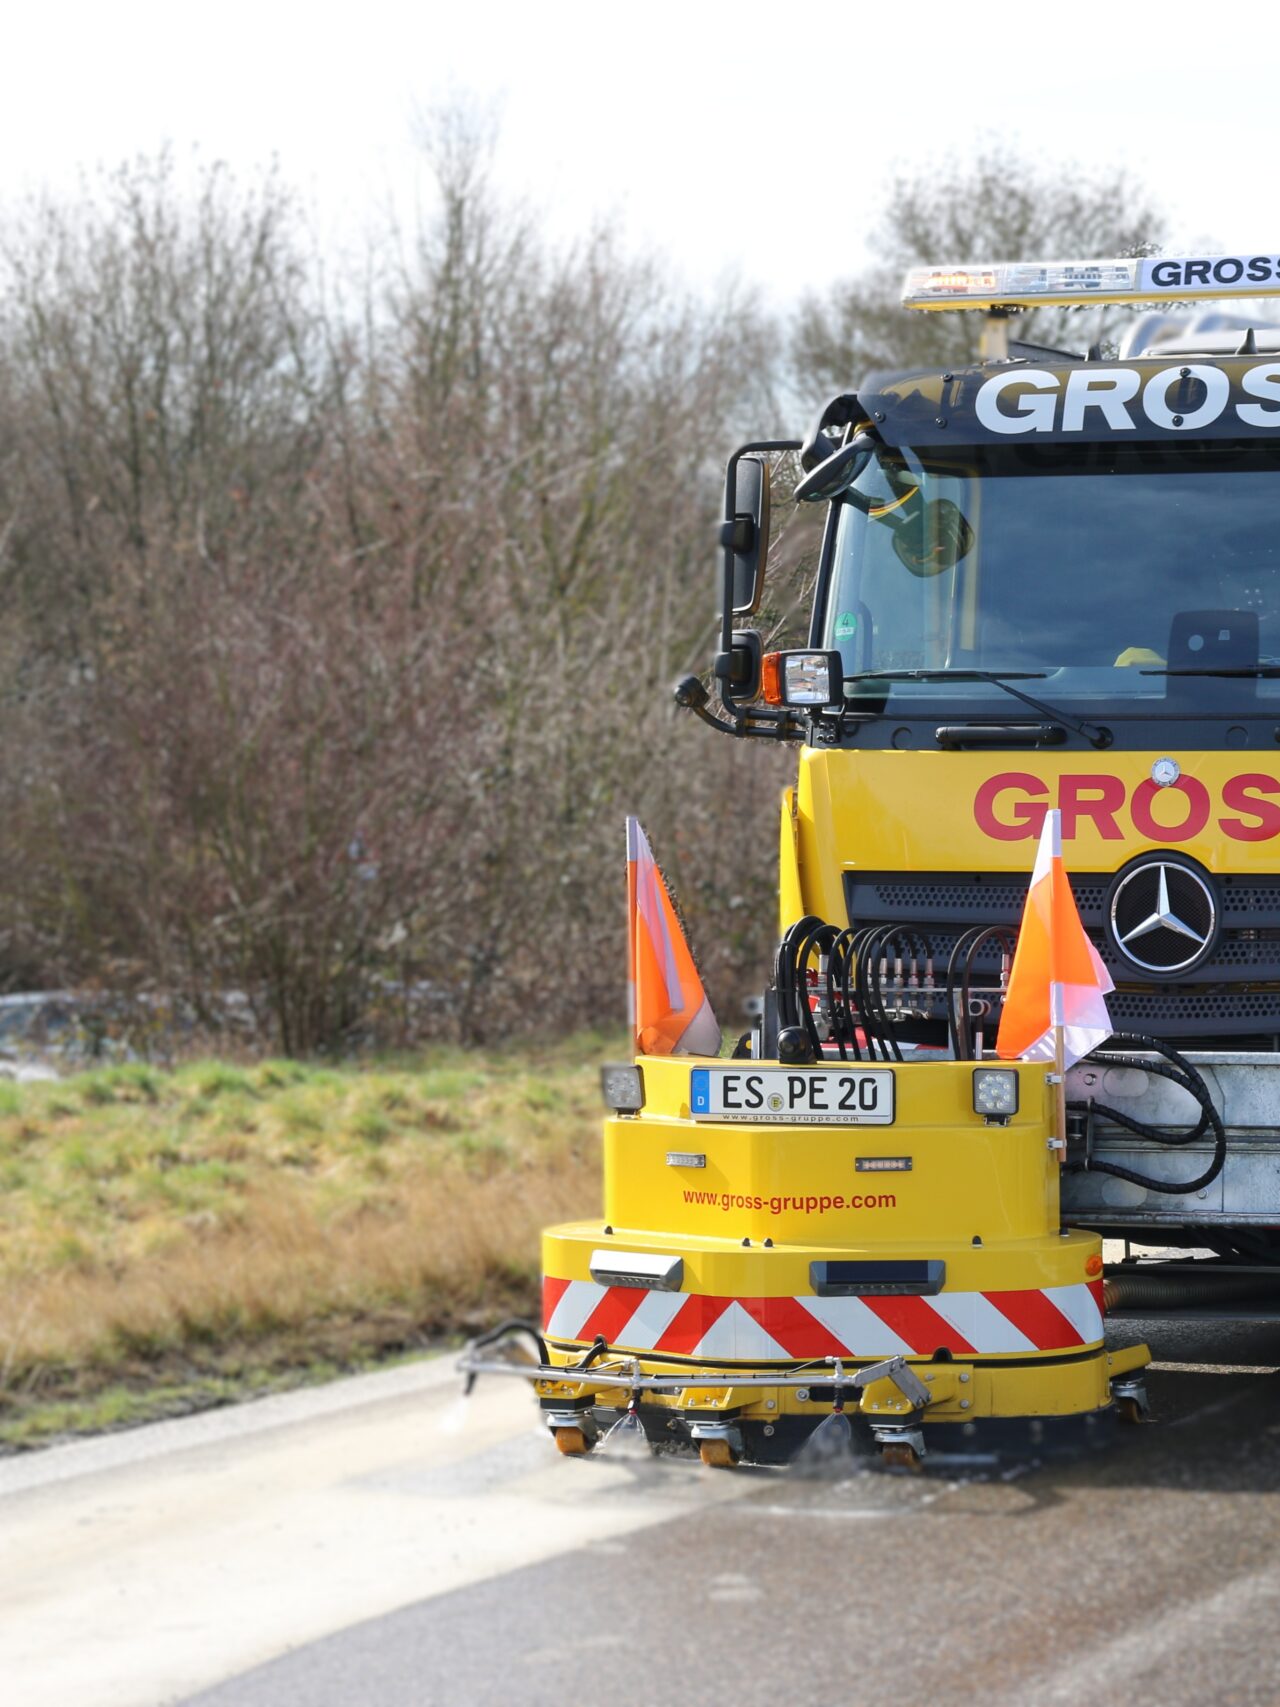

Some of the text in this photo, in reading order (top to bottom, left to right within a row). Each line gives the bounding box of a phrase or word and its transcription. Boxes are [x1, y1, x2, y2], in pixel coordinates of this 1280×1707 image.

[697, 1096, 704, 1105] D
[722, 1075, 878, 1111] ES PE 20
[723, 1114, 859, 1123] www.gross-gruppe.com
[683, 1188, 897, 1214] www.gross-gruppe.com
